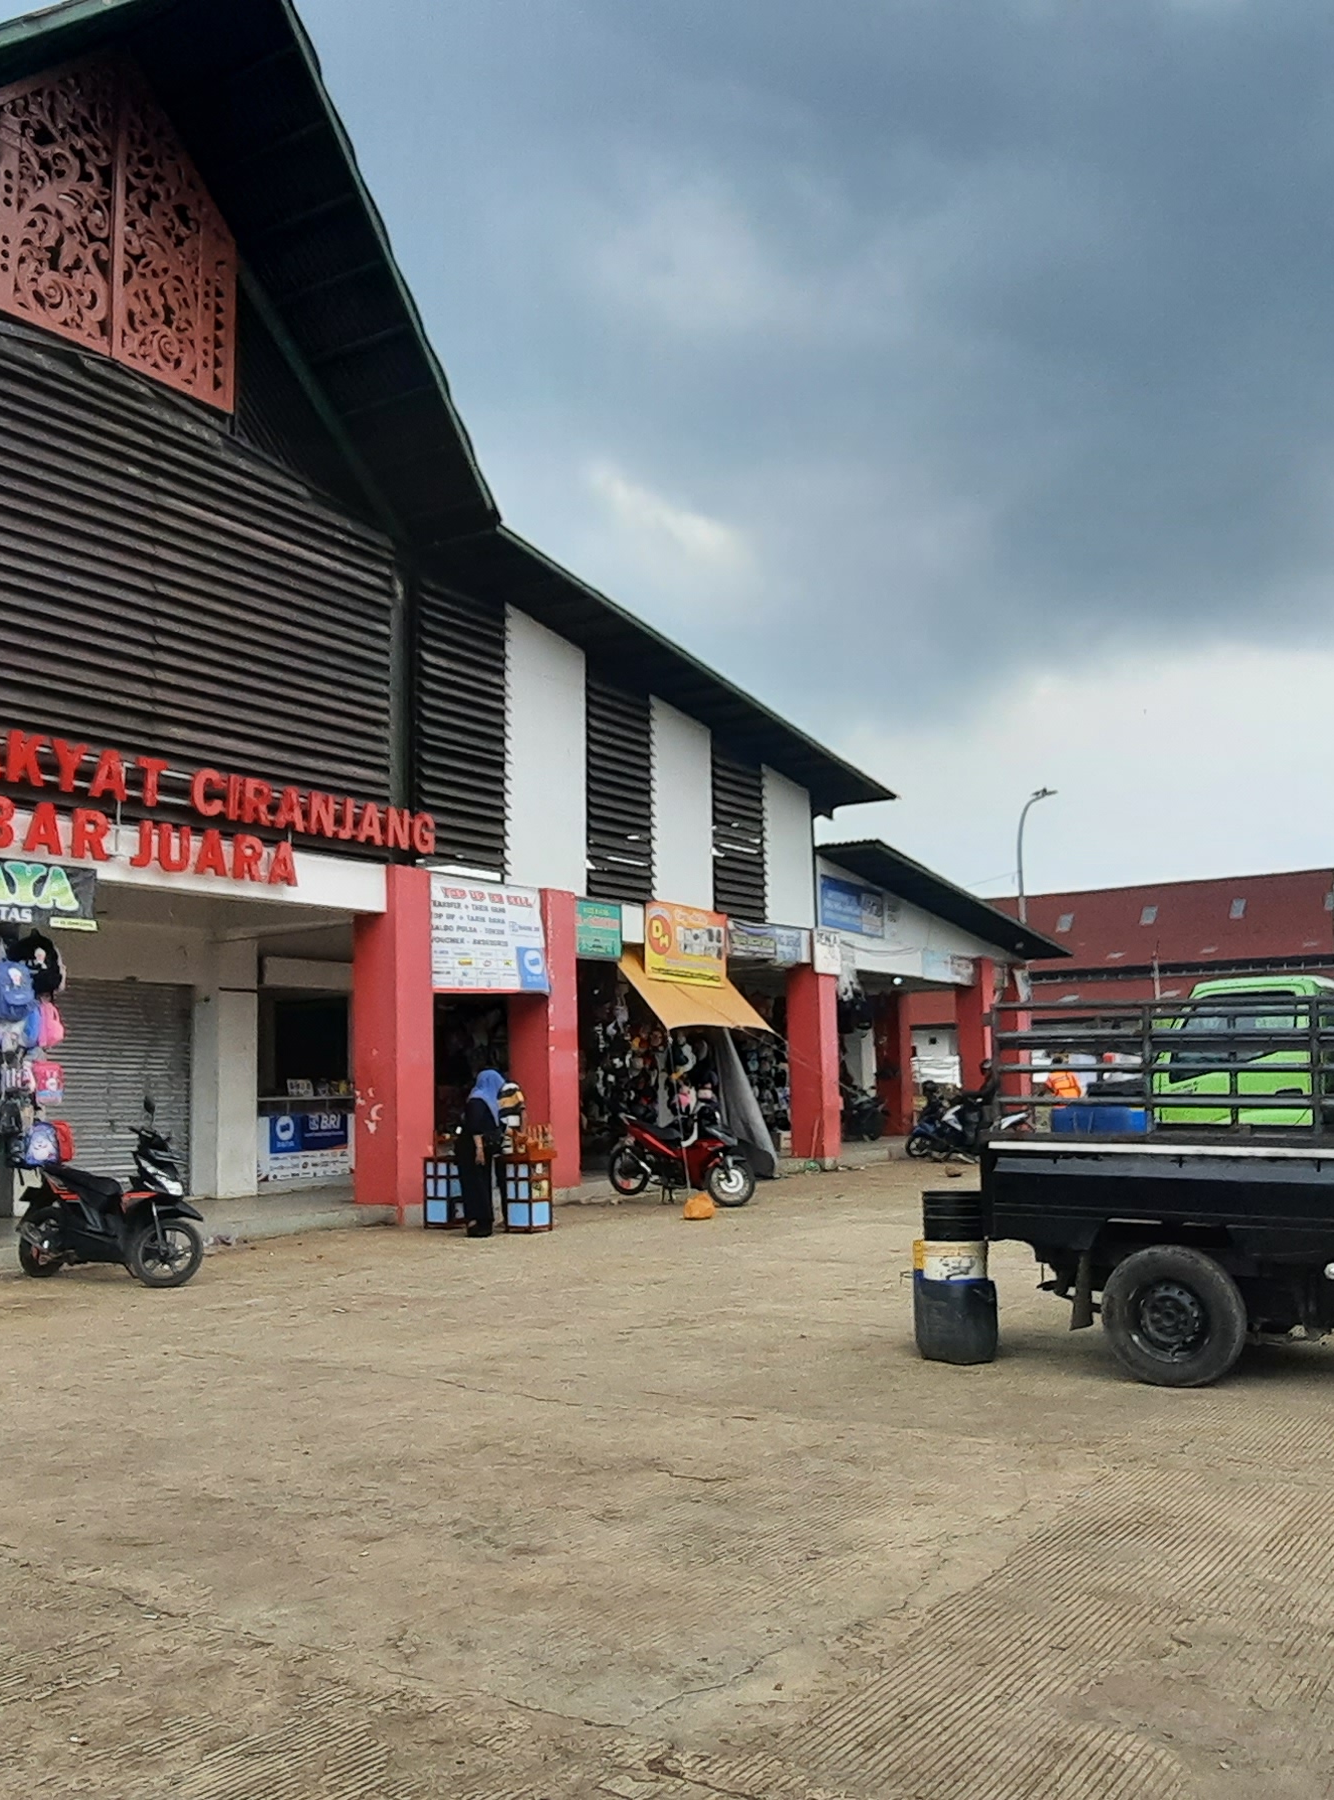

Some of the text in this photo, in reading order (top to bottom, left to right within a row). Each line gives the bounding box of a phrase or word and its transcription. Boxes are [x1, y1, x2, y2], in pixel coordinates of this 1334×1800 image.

[190, 767, 436, 855] CIRANJANG
[130, 819, 297, 887] JUARA
[0, 907, 33, 923] TAS
[320, 1113, 341, 1130] BRI
